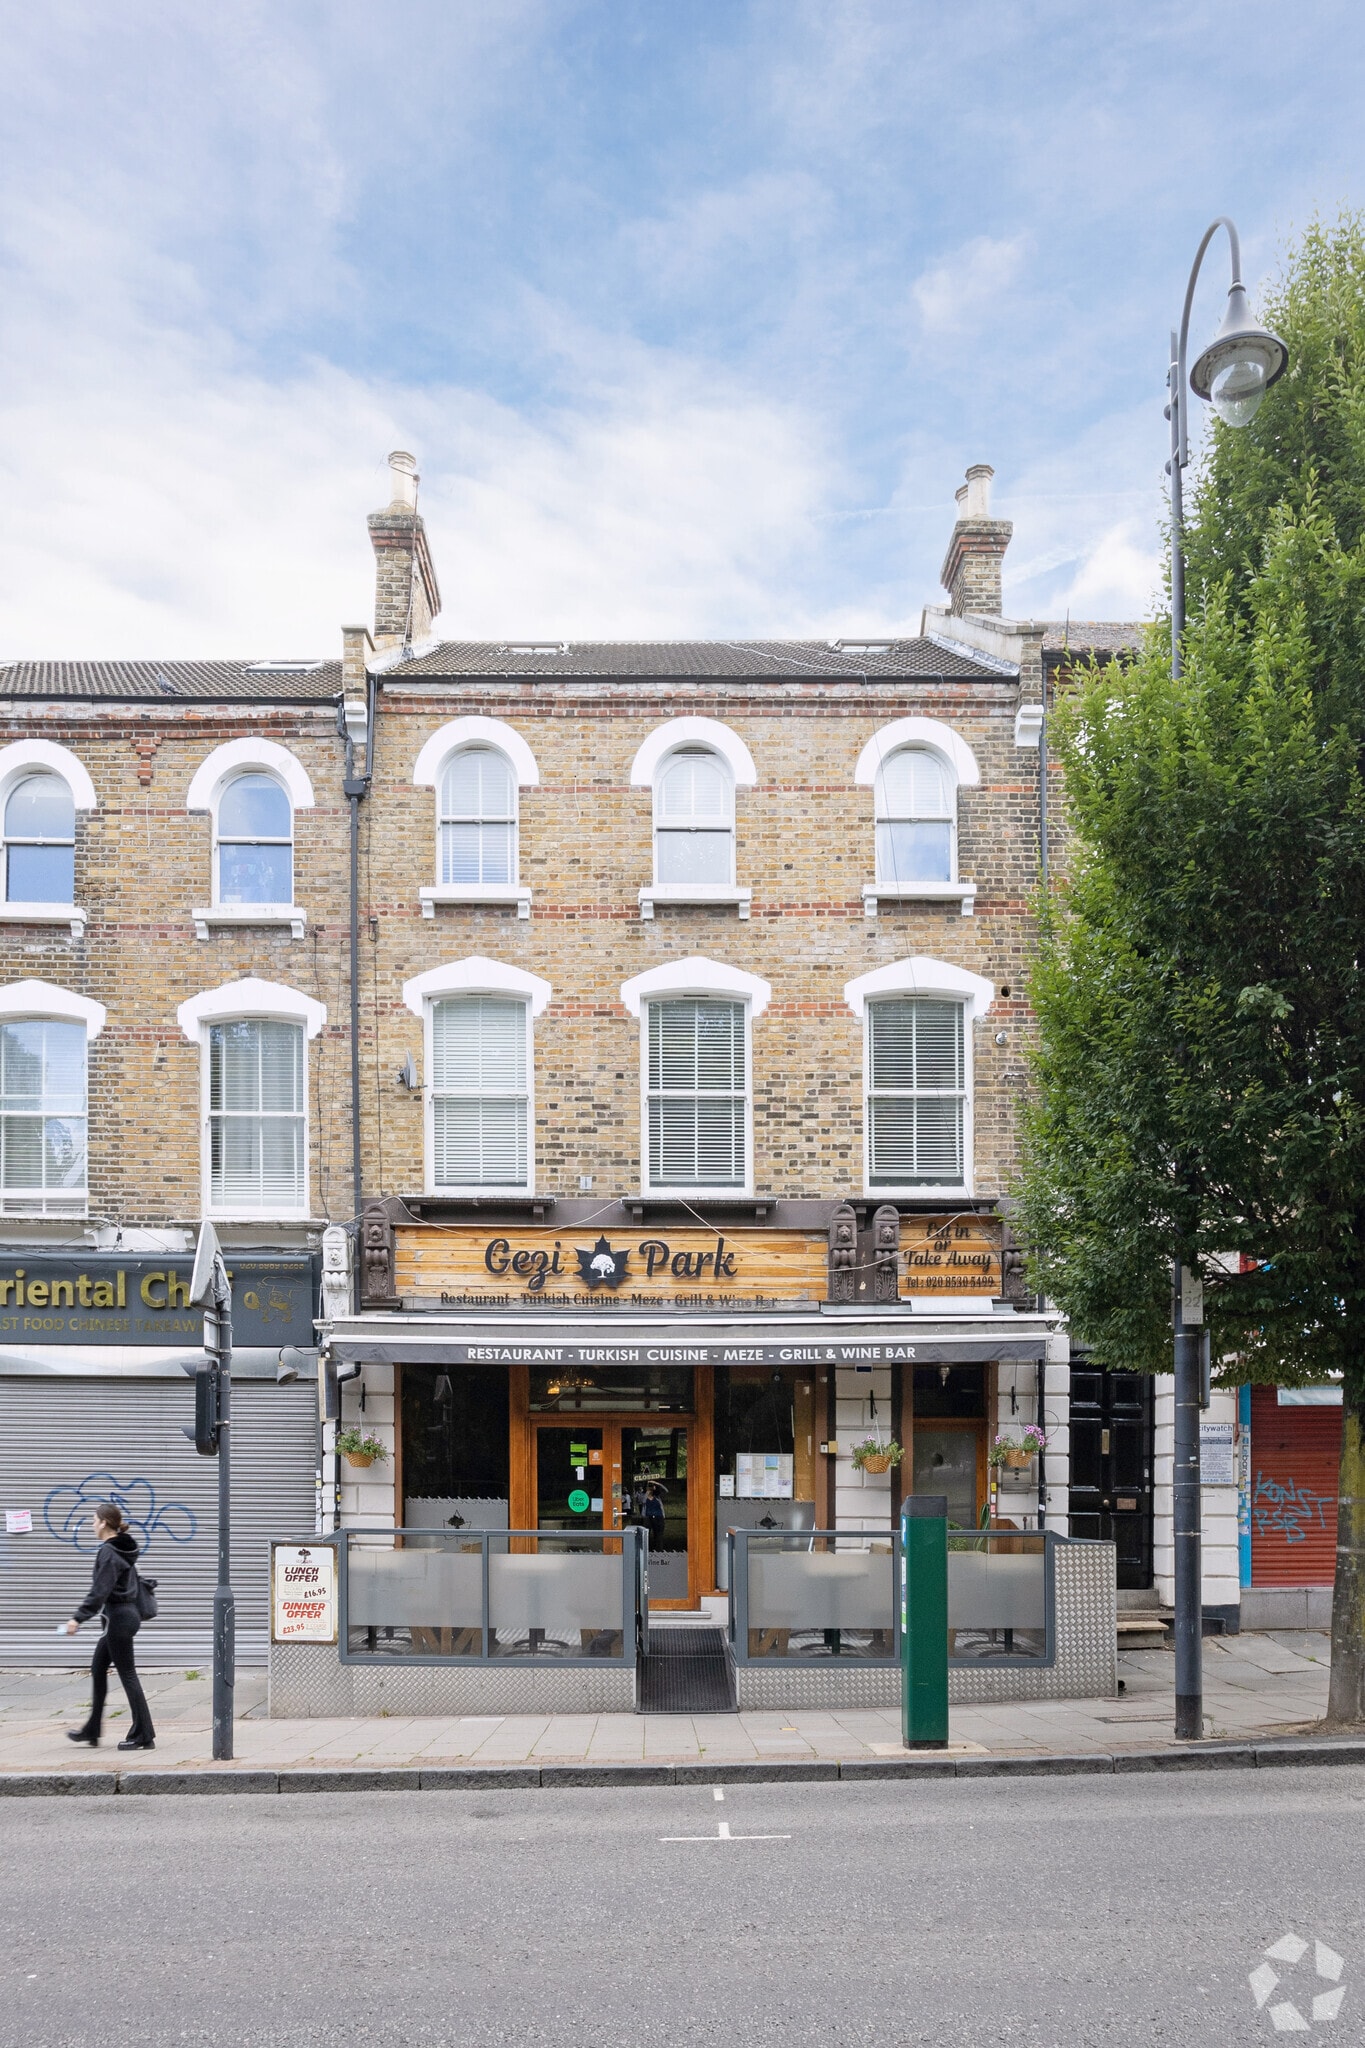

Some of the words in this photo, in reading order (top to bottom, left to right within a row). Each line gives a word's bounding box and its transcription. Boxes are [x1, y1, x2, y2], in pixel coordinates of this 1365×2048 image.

[926, 1222, 952, 1239] Eat
[955, 1223, 970, 1239] in
[934, 1239, 951, 1252] or
[484, 1238, 565, 1292] Gezi
[638, 1237, 738, 1280] Park
[904, 1250, 942, 1267] Take
[946, 1250, 992, 1274] Away
[926, 1276, 943, 1288] 020
[945, 1276, 968, 1288] 8530
[970, 1276, 994, 1288] 5499
[440, 1291, 510, 1305] Restaurant
[520, 1292, 570, 1305] Turkish
[573, 1292, 620, 1305] Cuisine
[631, 1293, 663, 1306] Meze
[674, 1293, 702, 1306] Grill
[706, 1293, 715, 1306] &
[719, 1294, 751, 1307] Wine
[755, 1294, 777, 1307] Bar
[1184, 1297, 1200, 1308] 22
[0, 1316, 19, 1330] ST
[24, 1317, 65, 1331] FOOD
[69, 1318, 130, 1332] CHINESE
[467, 1347, 564, 1361] RESTAURANT
[578, 1348, 639, 1361] TURKISH
[647, 1348, 708, 1362] CUISINE
[723, 1348, 764, 1361] MEZE
[779, 1348, 821, 1361] GRILL
[825, 1347, 836, 1360] &
[841, 1347, 882, 1360] WINE
[886, 1346, 916, 1359] BAR
[1199, 1425, 1233, 1433] itywatch
[633, 1473, 661, 1482] CLOSED
[284, 1566, 319, 1575] LUNCH
[285, 1574, 319, 1583] OFFER
[282, 1602, 326, 1611] DINNER
[286, 1610, 322, 1619] OFFER
